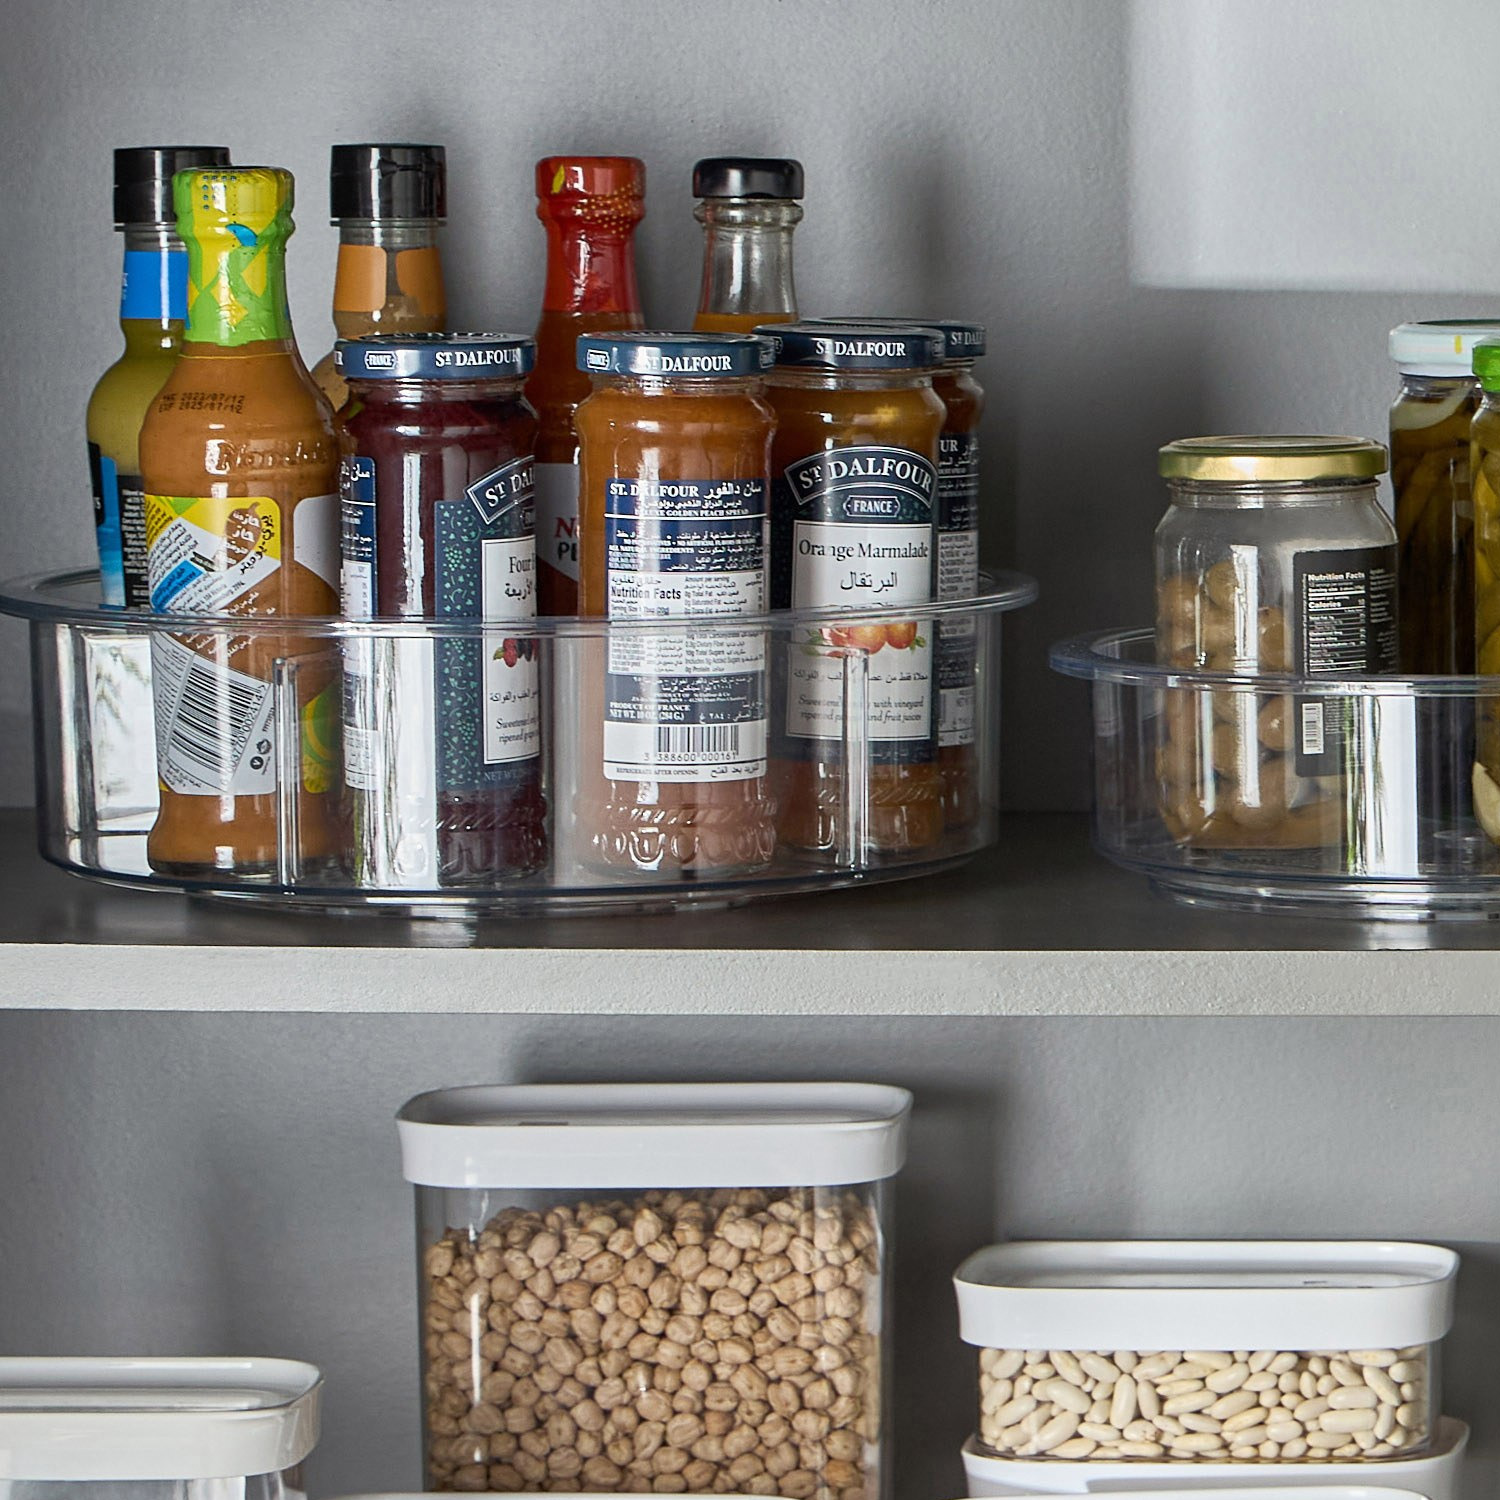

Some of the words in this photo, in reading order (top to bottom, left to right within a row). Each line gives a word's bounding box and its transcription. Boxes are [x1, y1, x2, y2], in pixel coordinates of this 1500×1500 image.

[815, 341, 833, 355] ST
[834, 341, 906, 357] DALFOUR
[435, 351, 451, 367] ST
[660, 355, 733, 372] DALFOUR
[799, 465, 823, 489] ST
[826, 457, 932, 493] DALFOUR
[485, 481, 507, 507] ST
[609, 484, 628, 497] ST.
[703, 481, 741, 499] دالفور
[666, 509, 699, 518] GOLDEN
[700, 509, 725, 518] PEACH
[853, 500, 893, 513] FRANCE
[799, 539, 854, 562] Orange
[857, 541, 929, 558] Marmalade
[840, 570, 898, 593] البرتقال
[1307, 573, 1345, 582] Nutrition
[611, 586, 650, 600] Nutrition
[653, 587, 682, 600] Facts
[656, 702, 692, 712] FRANCE
[656, 752, 697, 762] 388600
[701, 752, 737, 762] 000161
